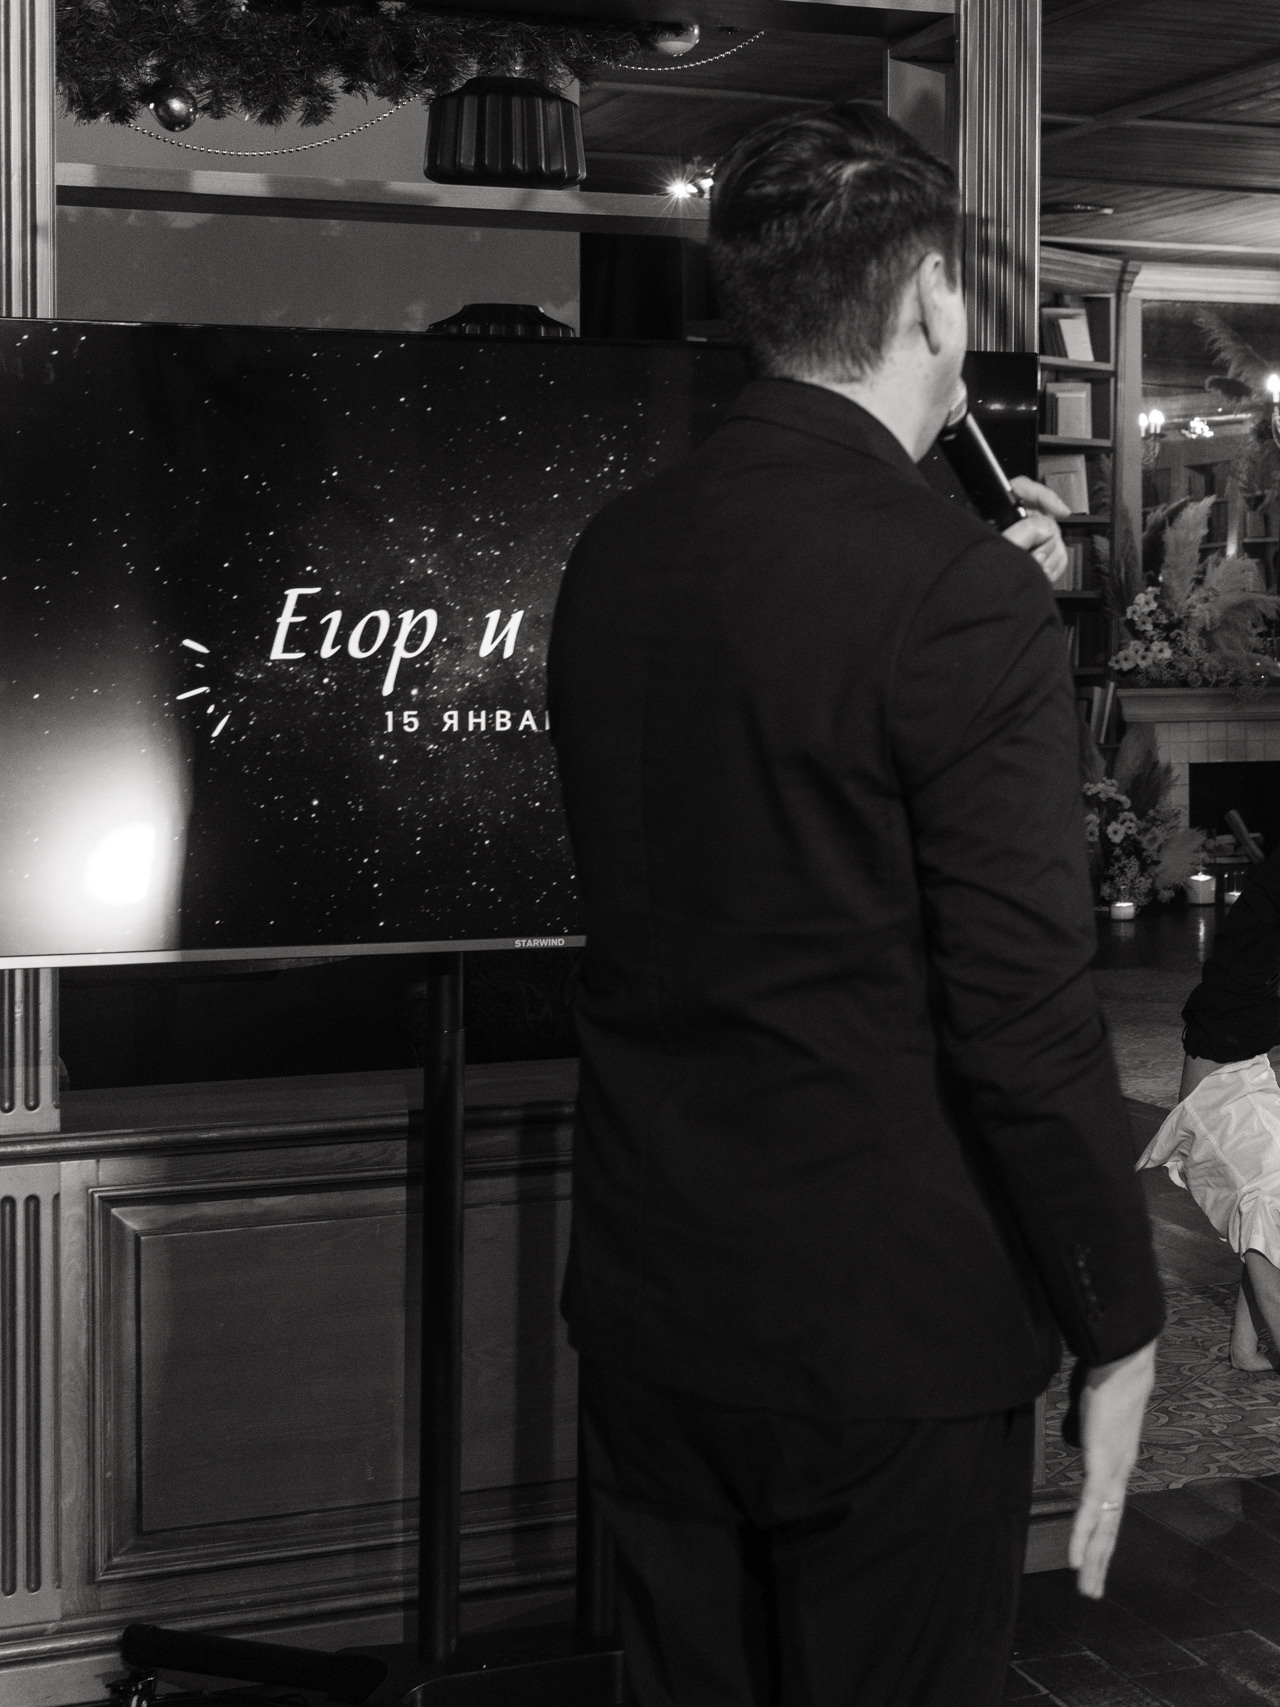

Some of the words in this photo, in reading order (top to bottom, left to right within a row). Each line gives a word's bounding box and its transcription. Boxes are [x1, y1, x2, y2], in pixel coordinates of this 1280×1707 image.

[270, 587, 438, 696] Егор
[479, 609, 525, 659] и
[384, 710, 419, 733] 15
[442, 709, 551, 732] ЯНВА
[515, 938, 565, 948] STARWIND
